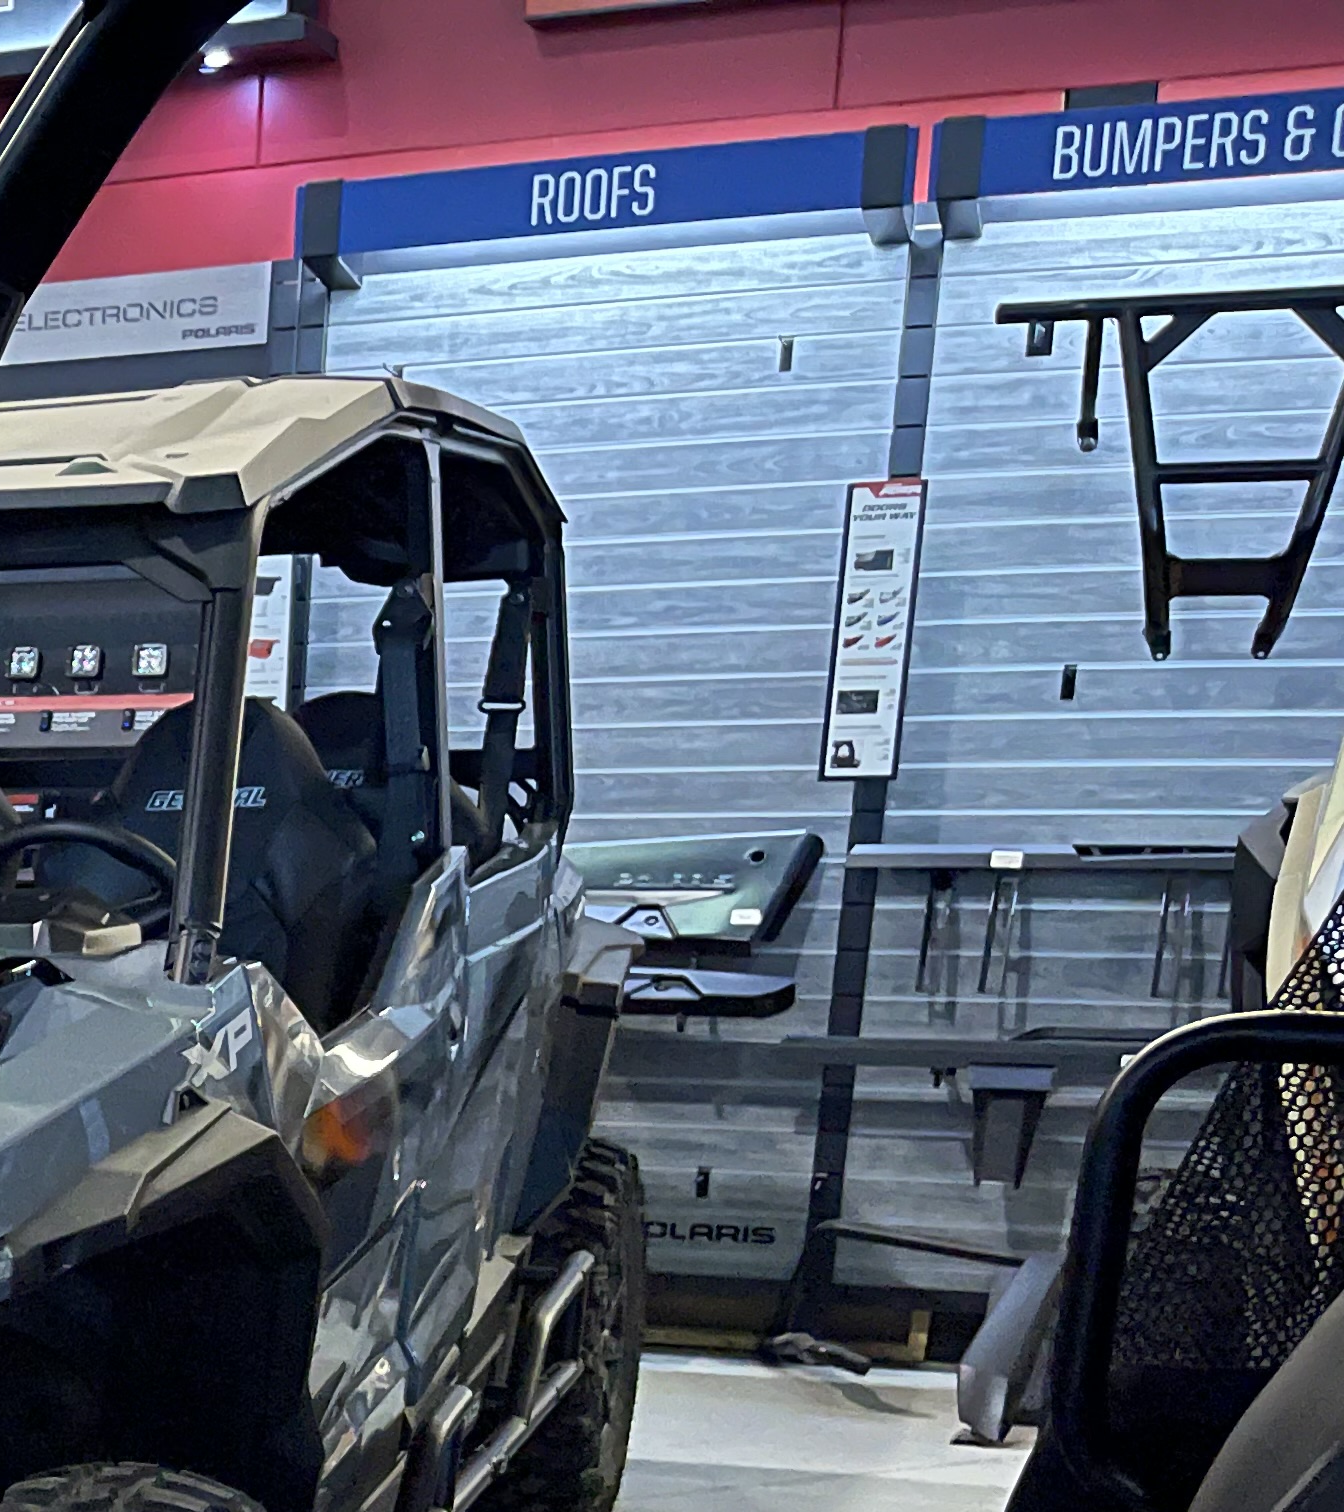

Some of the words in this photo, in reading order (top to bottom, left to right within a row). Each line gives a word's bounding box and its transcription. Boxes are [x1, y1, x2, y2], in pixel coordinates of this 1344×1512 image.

[1052, 109, 1268, 181] BUMPERS
[1283, 105, 1316, 162] &
[531, 163, 657, 227] ROOFS
[14, 296, 219, 332] ELECTRONICS
[182, 323, 257, 340] POLARIS
[145, 788, 267, 812] GEAL
[181, 1007, 253, 1088] XP
[643, 1221, 776, 1245] OLARIS
